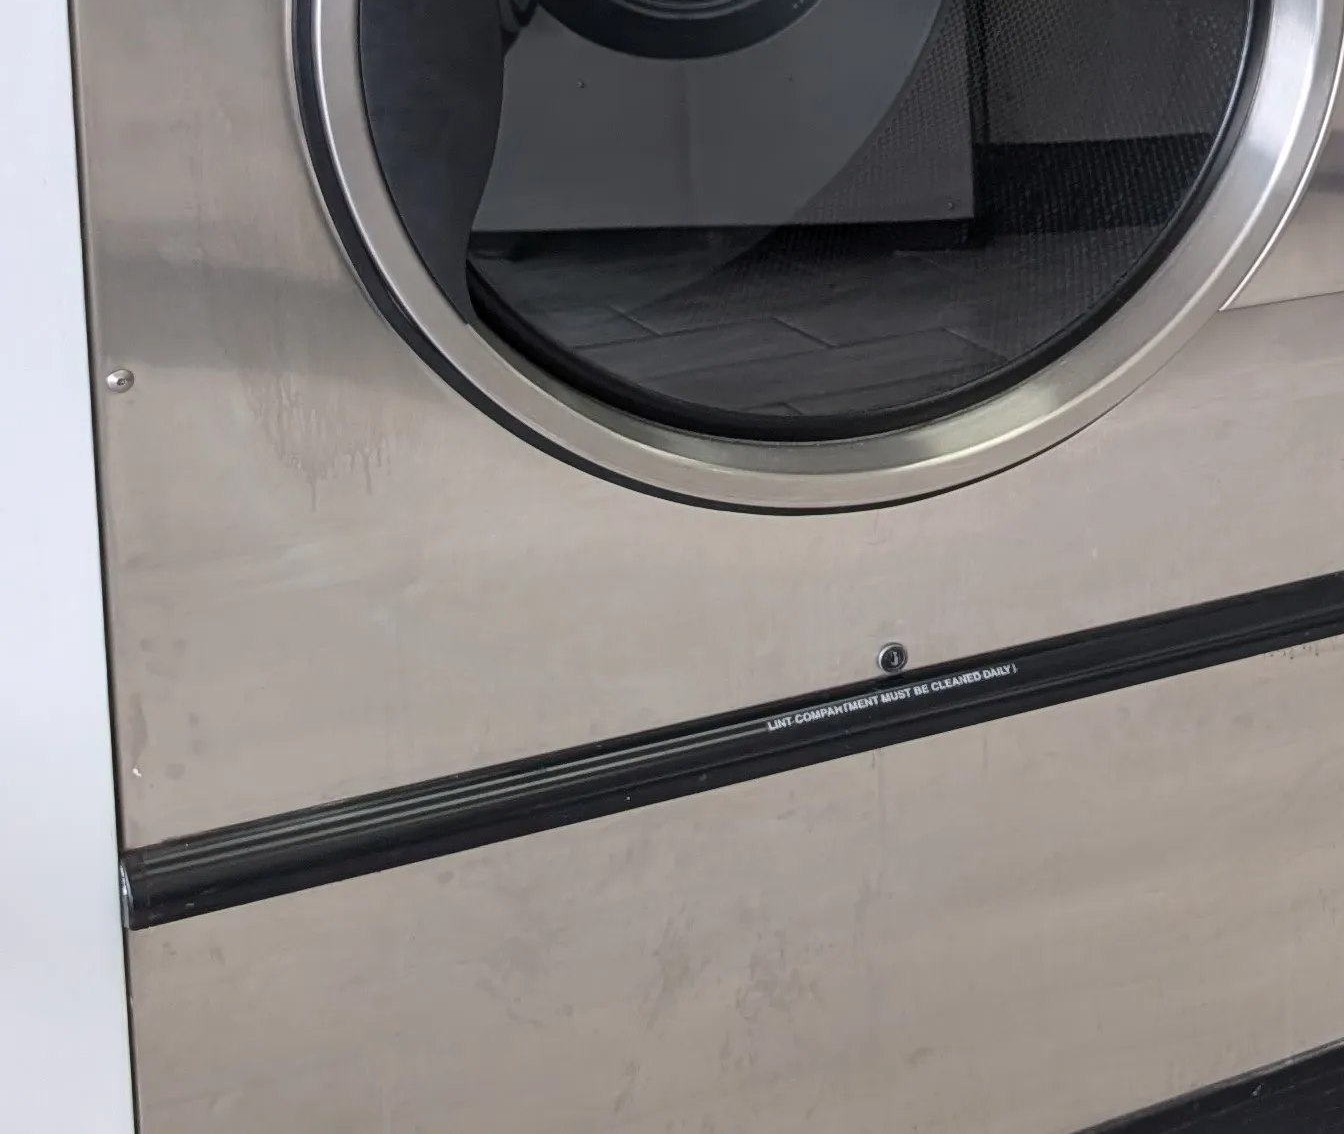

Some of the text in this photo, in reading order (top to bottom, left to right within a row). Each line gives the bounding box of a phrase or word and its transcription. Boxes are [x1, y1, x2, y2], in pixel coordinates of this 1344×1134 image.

[768, 715, 793, 732] LINT
[794, 695, 879, 724] COMPARTMENT
[880, 687, 912, 703] MUST
[914, 683, 930, 696] BE
[930, 670, 982, 692] CLEANED
